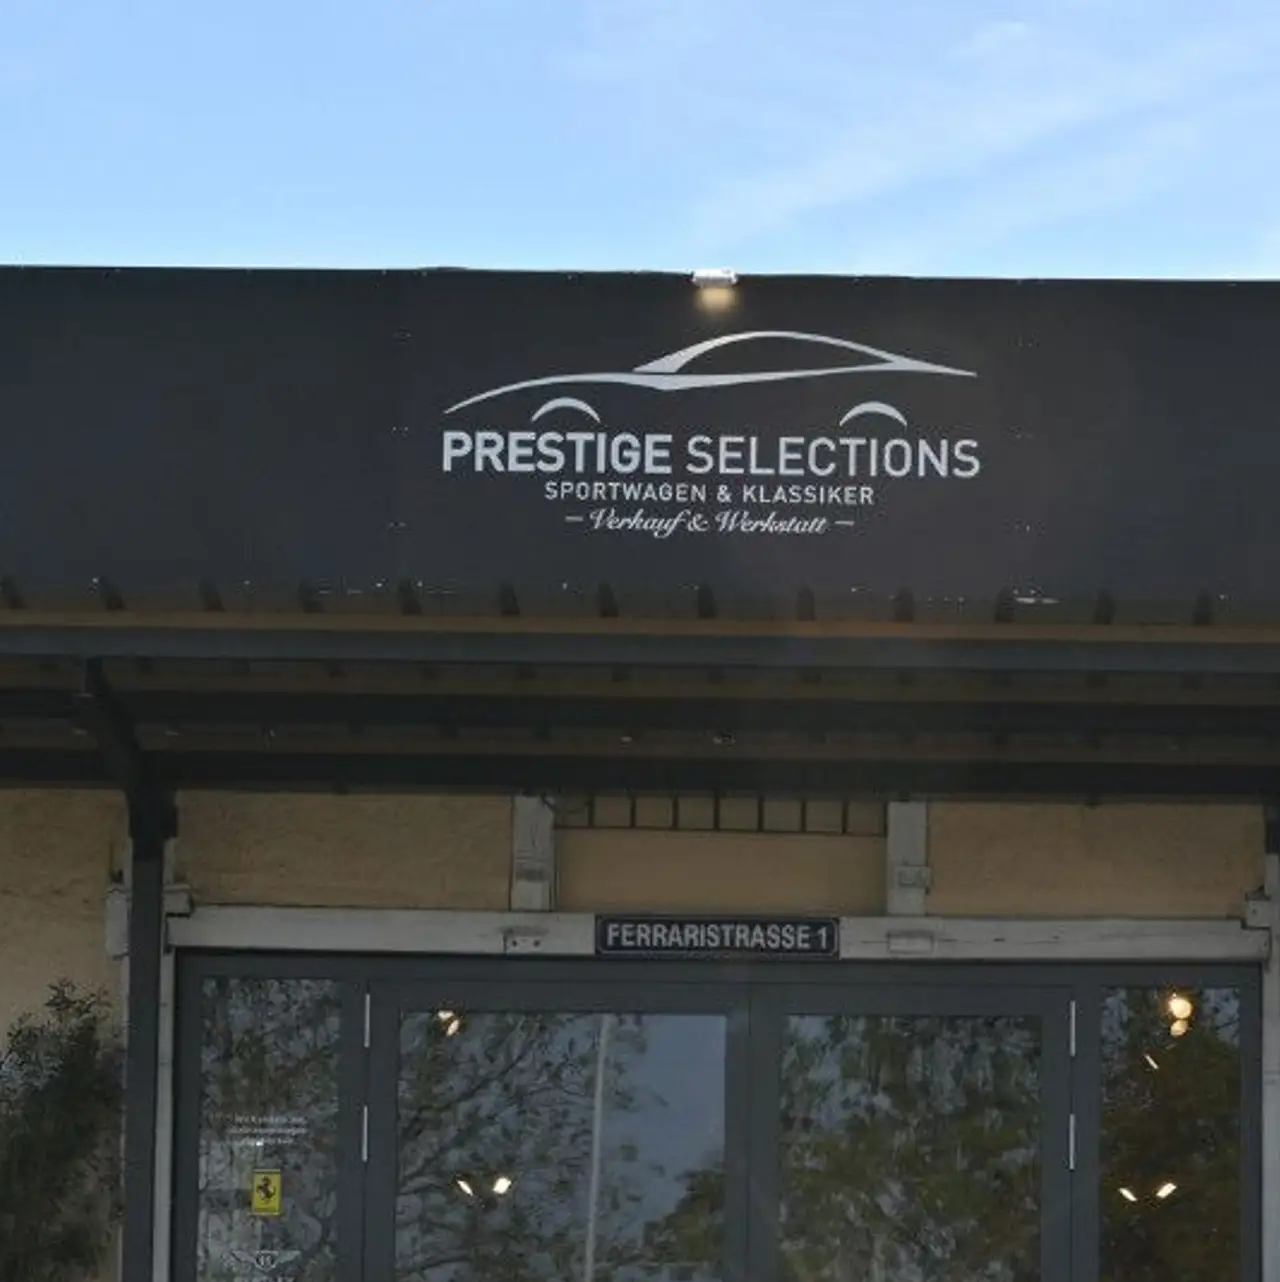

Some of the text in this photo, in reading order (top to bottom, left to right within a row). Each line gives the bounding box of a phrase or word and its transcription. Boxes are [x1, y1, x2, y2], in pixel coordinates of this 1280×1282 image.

[442, 431, 981, 478] PRESTIGE SELECTIONS
[544, 481, 874, 506] SPORTWAGEN & KLASSIKER
[589, 509, 827, 537] Verkauf & Werkstatt
[607, 923, 827, 949] FERRARISTRASSE 1
